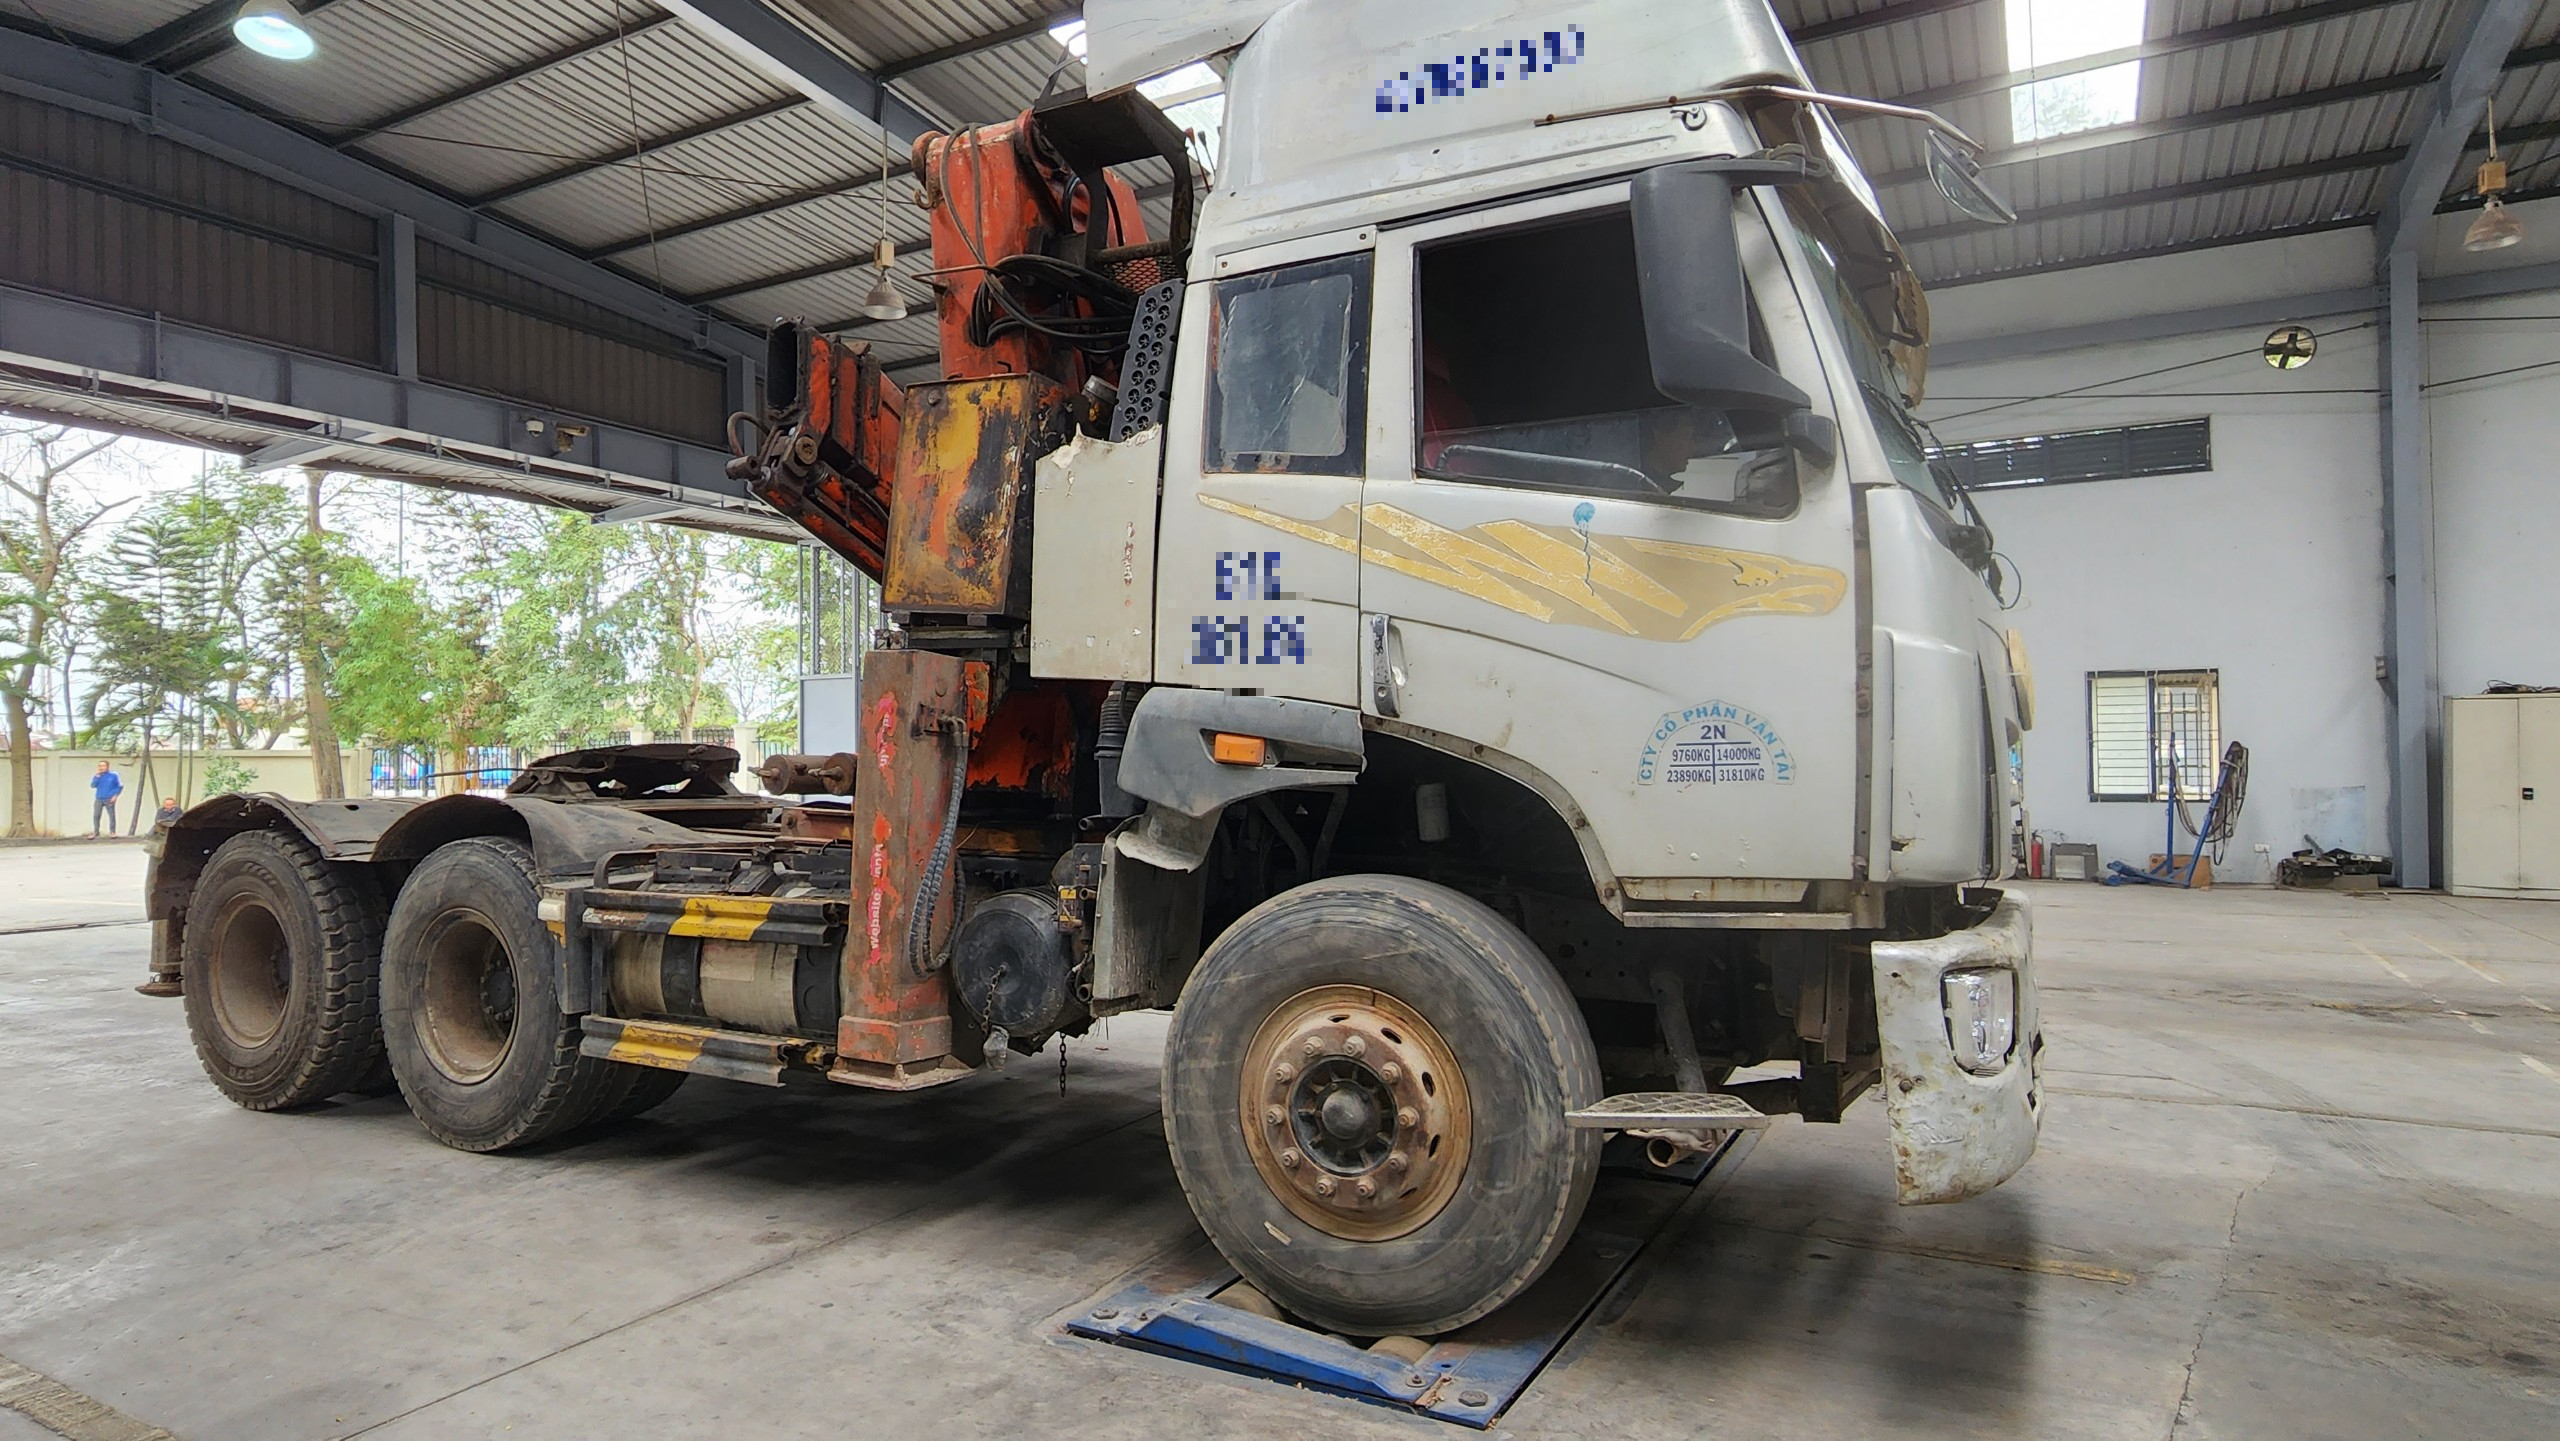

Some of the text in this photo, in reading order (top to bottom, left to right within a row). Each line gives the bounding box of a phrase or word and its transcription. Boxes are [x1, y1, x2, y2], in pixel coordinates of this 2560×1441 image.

[1700, 725, 1726, 740] 2N
[1640, 745, 1656, 779] CTY
[1672, 747, 1761, 762] 9760KG 14000KG
[1667, 768, 1765, 783] 23890KG 31810KG
